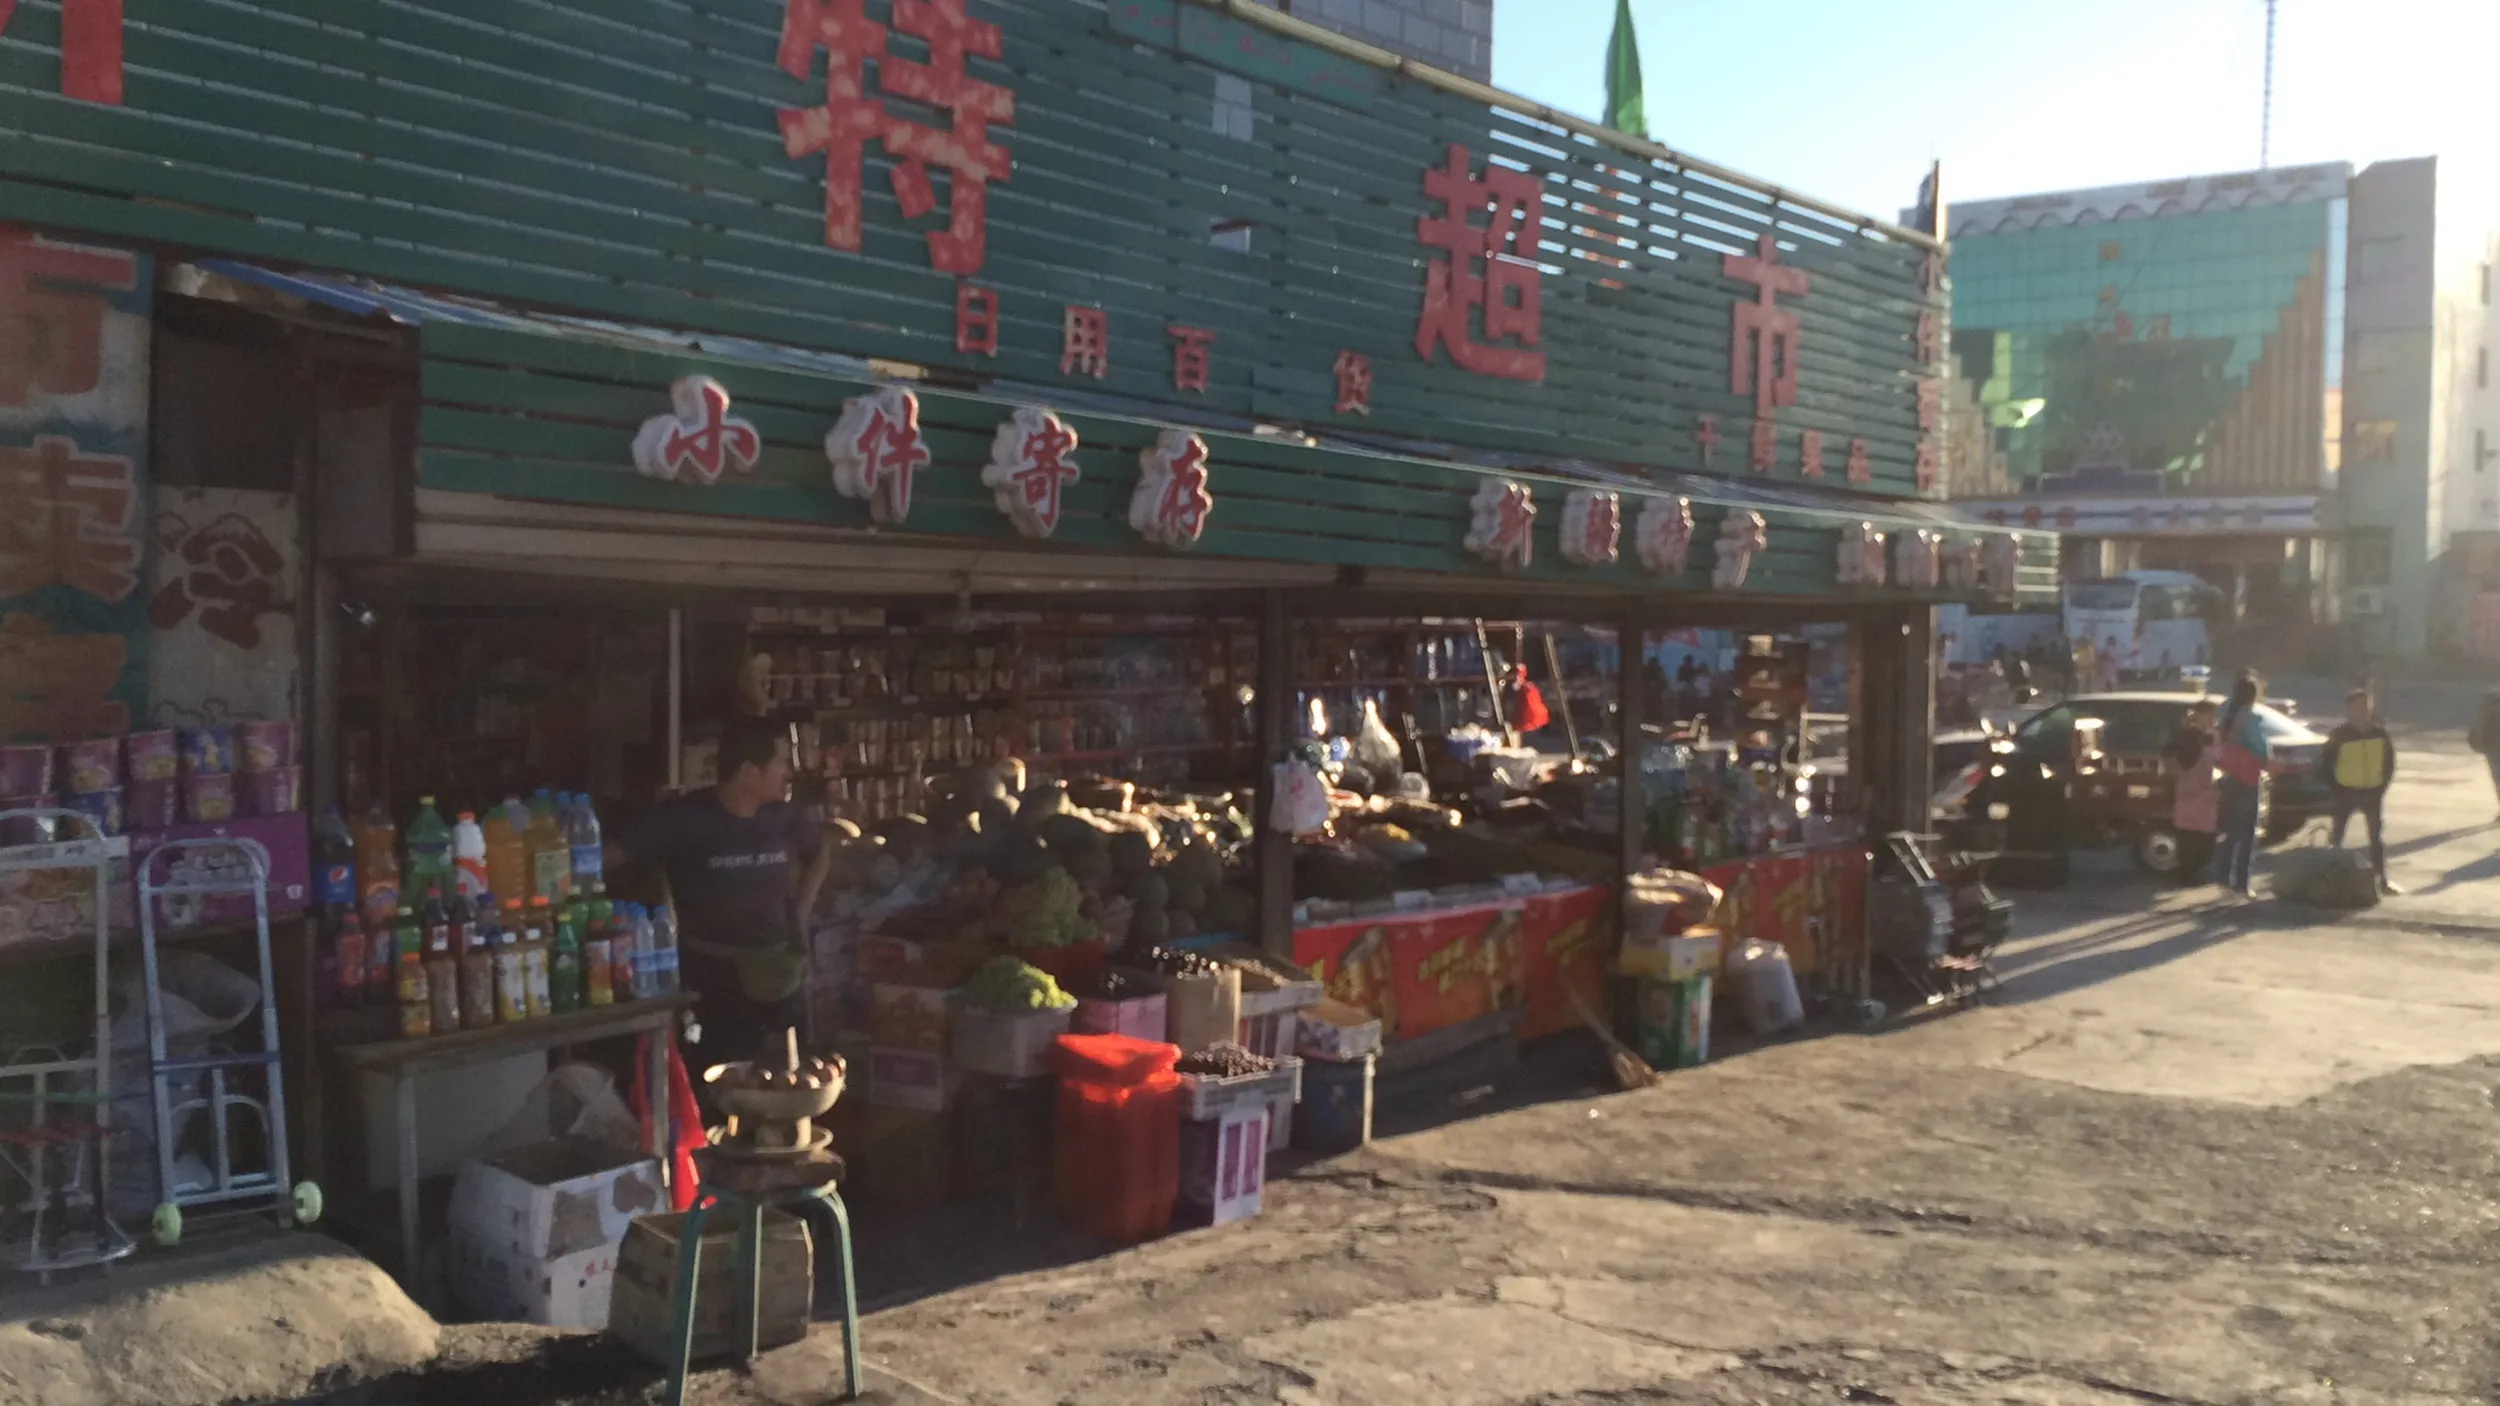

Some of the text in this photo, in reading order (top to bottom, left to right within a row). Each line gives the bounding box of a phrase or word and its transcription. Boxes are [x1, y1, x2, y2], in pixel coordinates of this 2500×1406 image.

[954, 283, 1376, 418] 日用百货
[633, 374, 1213, 547] 小件寄存
